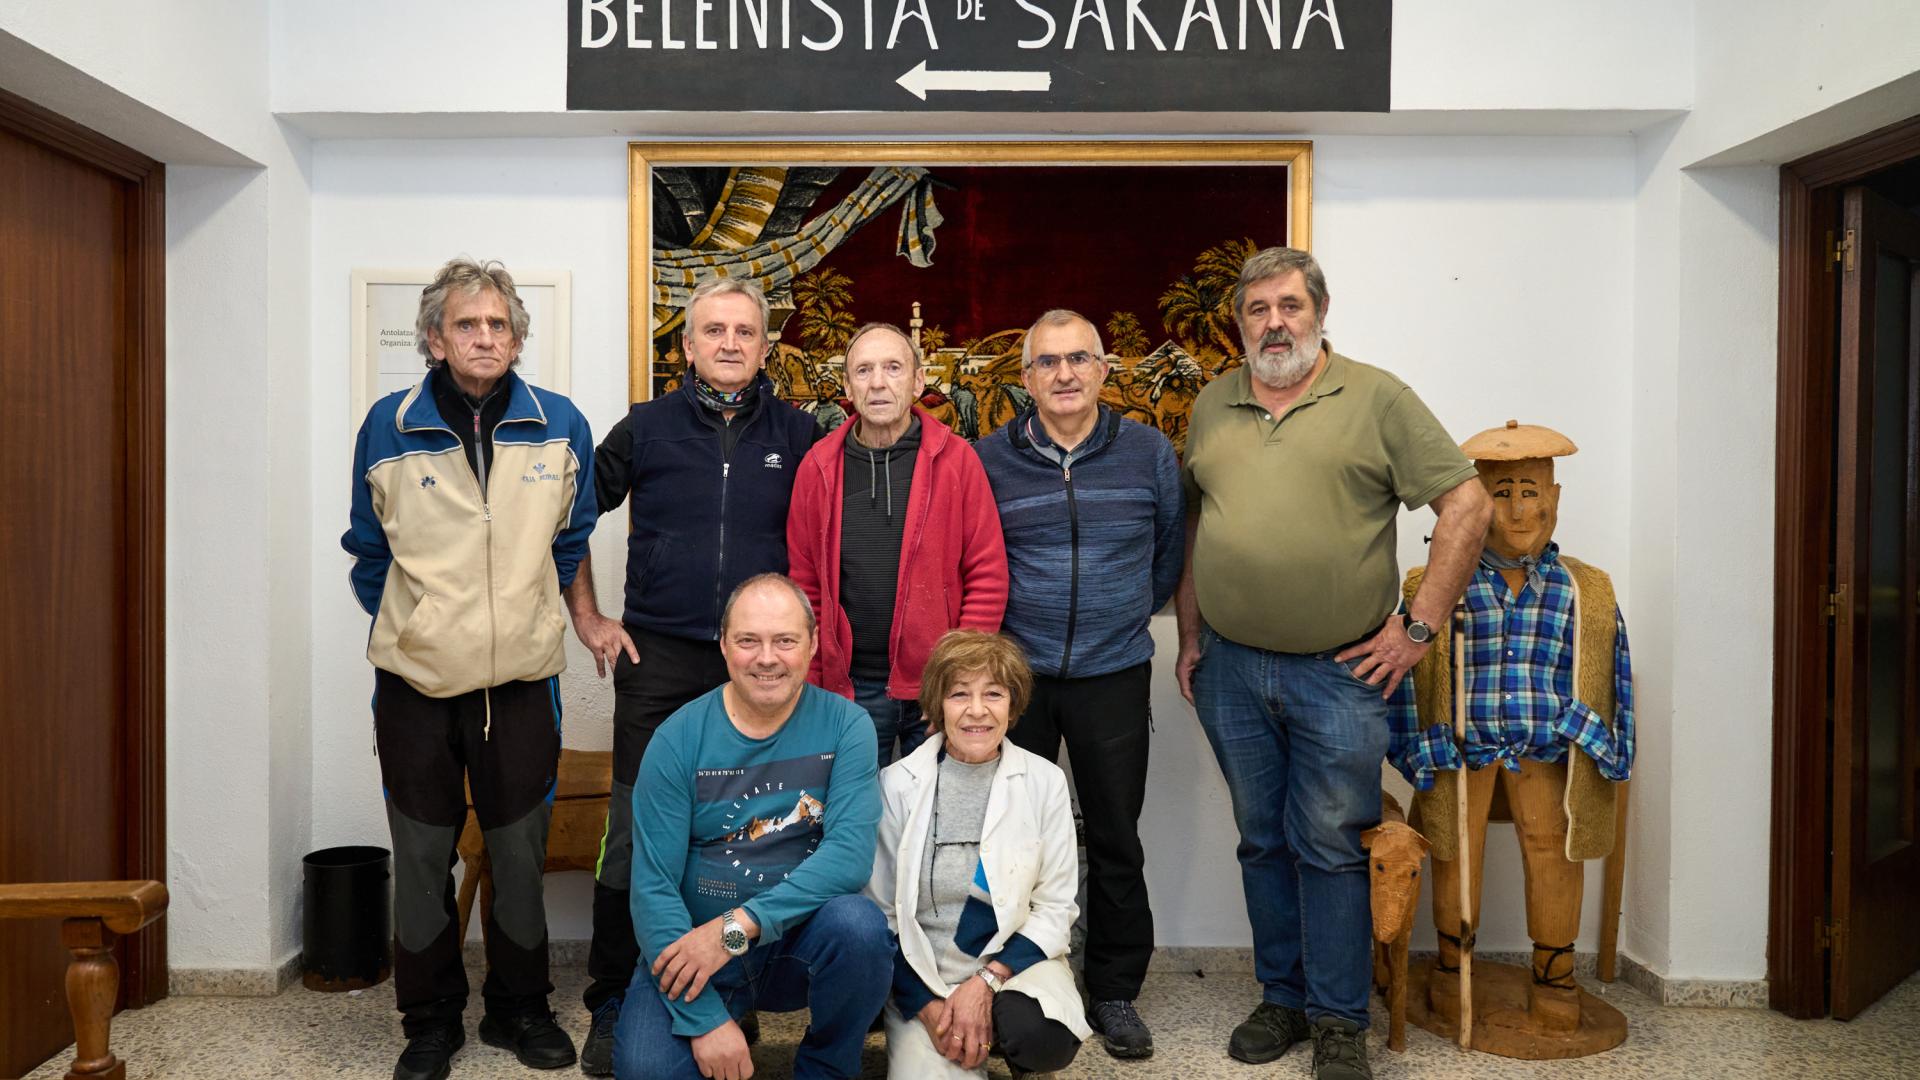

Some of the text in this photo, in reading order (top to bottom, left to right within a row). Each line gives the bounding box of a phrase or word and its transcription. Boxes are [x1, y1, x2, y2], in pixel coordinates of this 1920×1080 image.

[581, 0, 1344, 51] BELENISTA DE SAKANA
[722, 782, 784, 830] ELEVATE
